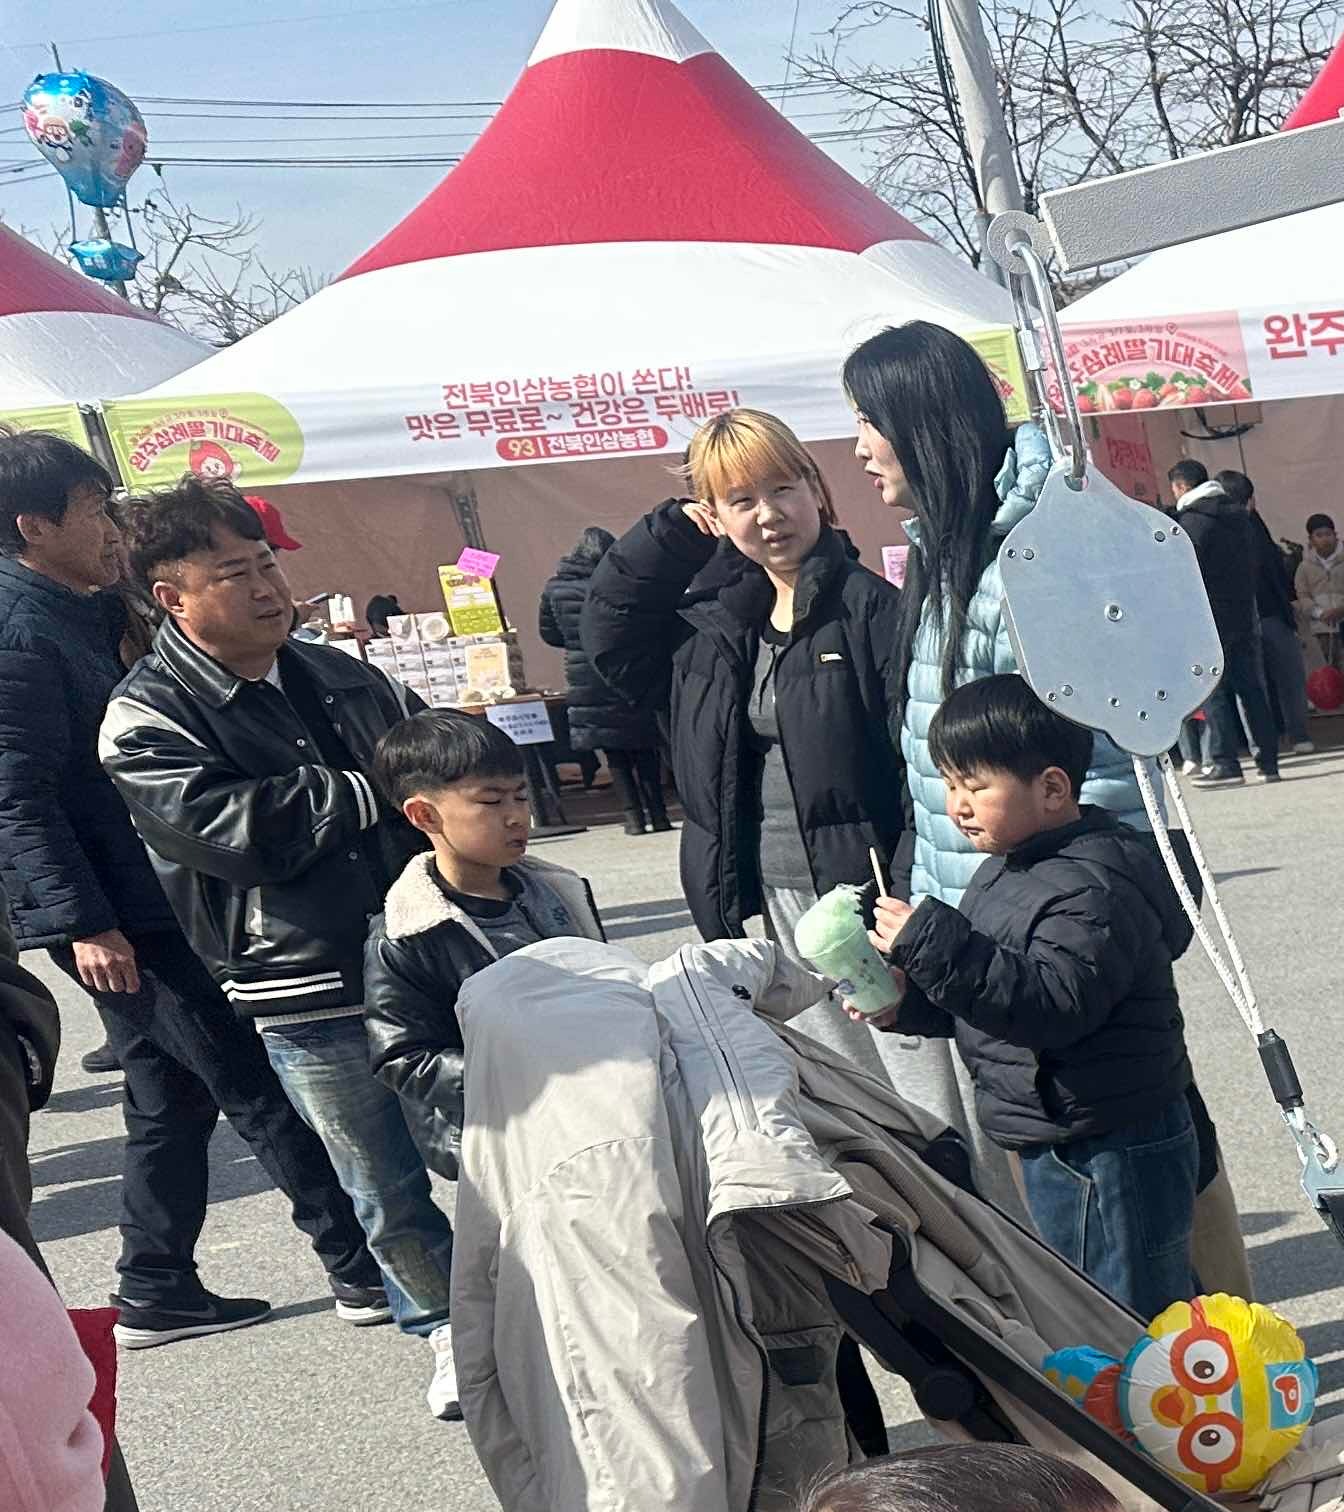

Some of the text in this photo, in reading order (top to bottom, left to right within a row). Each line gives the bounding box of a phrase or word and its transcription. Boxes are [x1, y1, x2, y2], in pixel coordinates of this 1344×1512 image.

[442, 366, 694, 411] 전북인삼농협이 쏜다!
[571, 399, 651, 429] 건강은
[508, 428, 656, 457] 93 전북인삼농협
